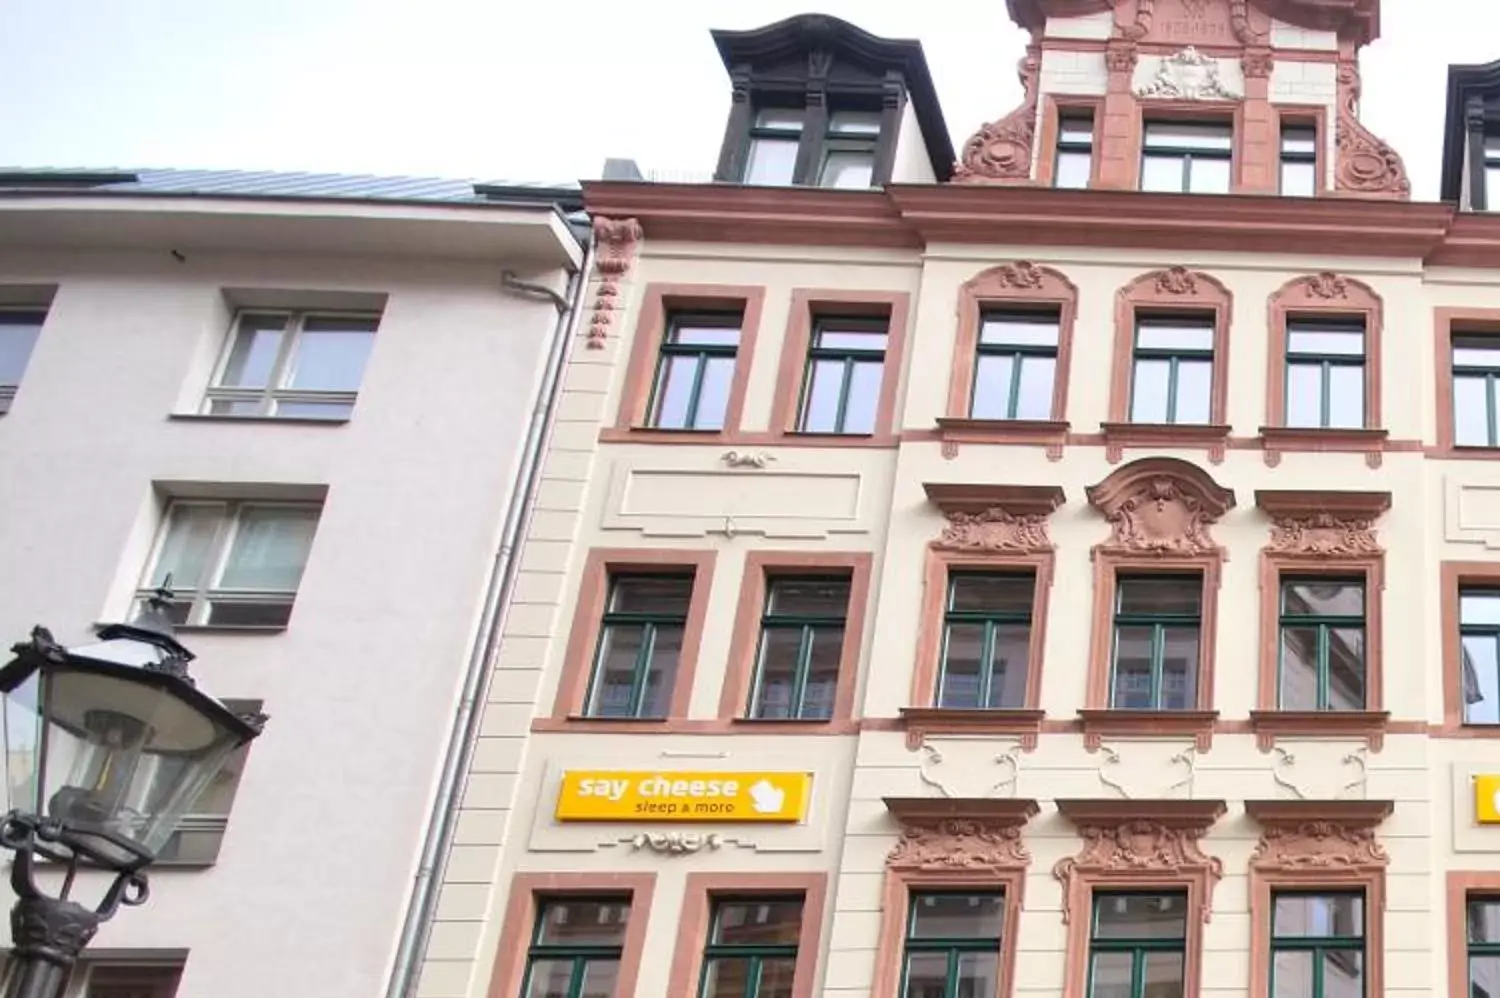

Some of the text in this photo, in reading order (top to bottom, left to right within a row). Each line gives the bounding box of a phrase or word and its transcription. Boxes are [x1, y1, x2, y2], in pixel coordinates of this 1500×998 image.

[578, 775, 740, 801] say cheese
[635, 801, 678, 814] sleep
[695, 801, 736, 813] more
